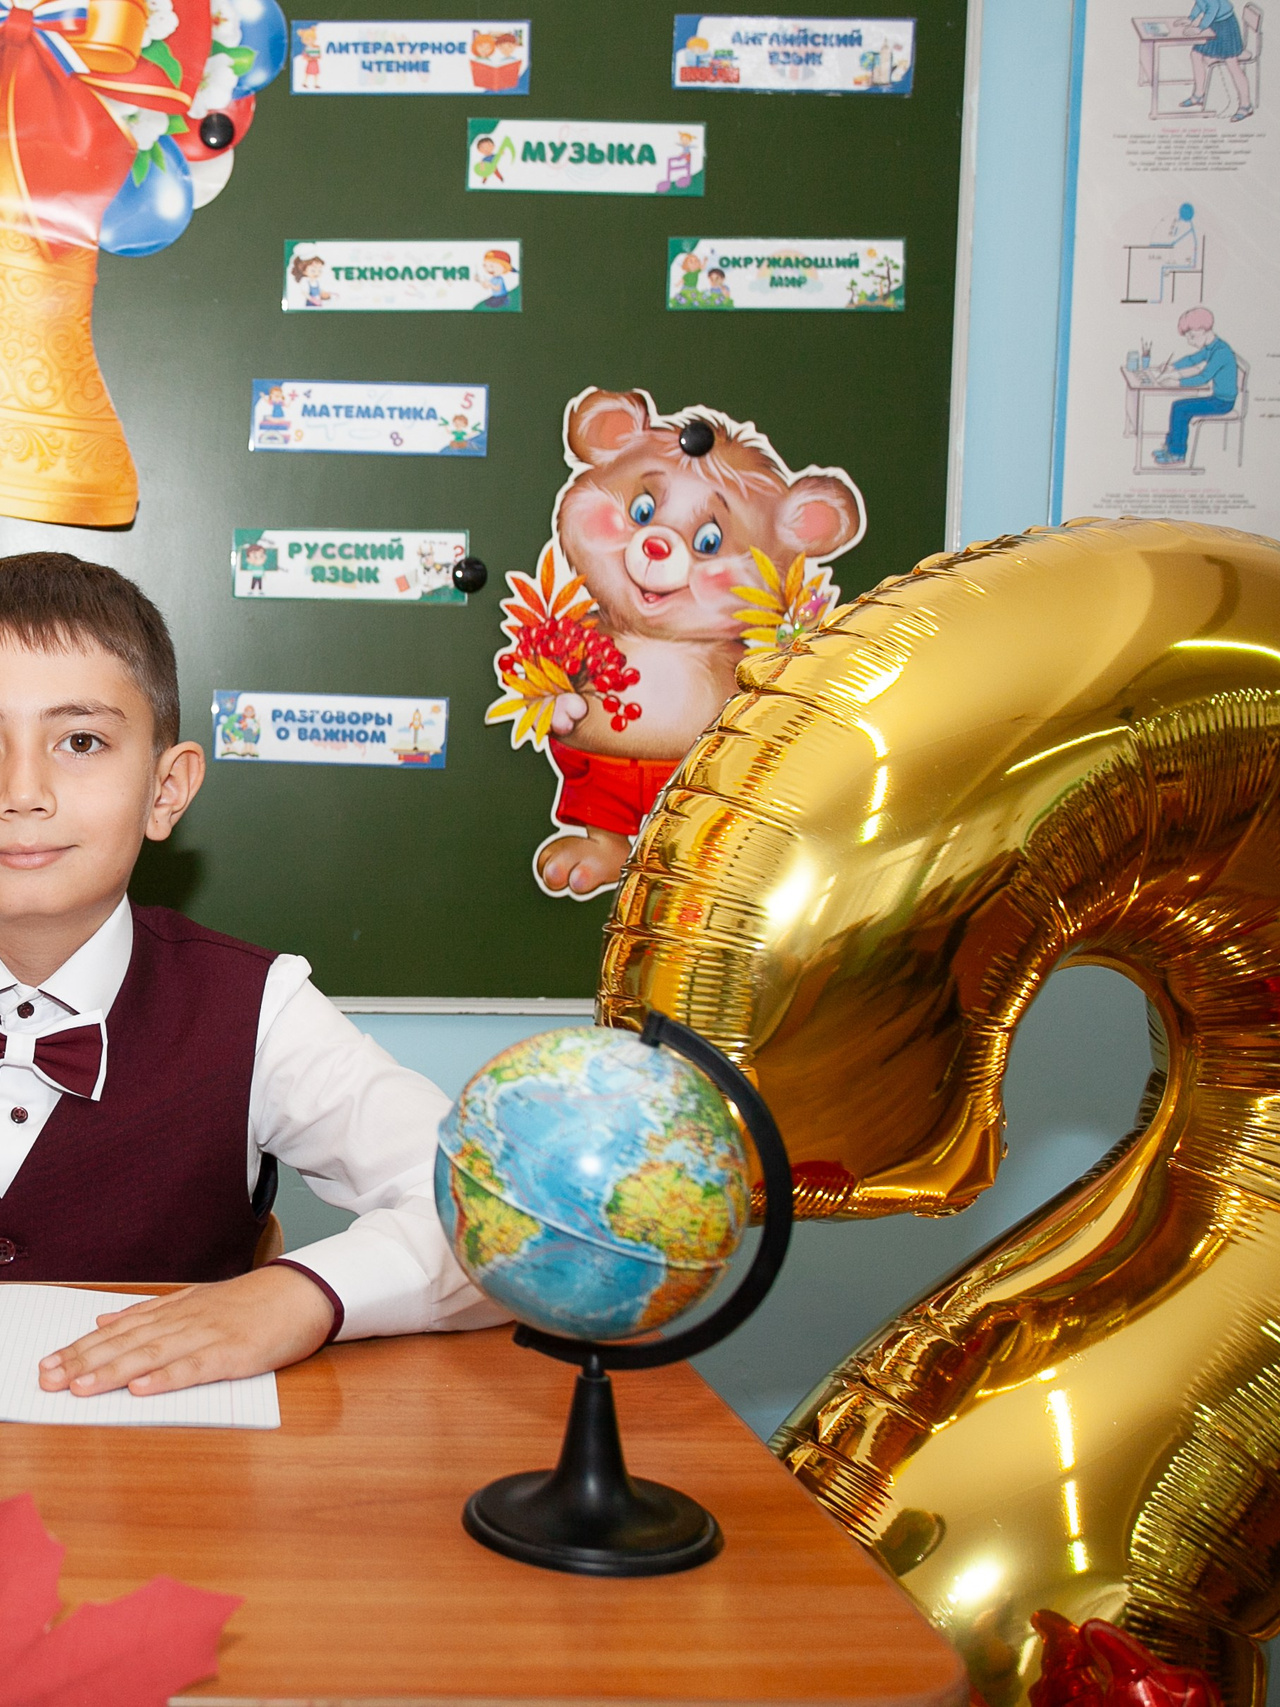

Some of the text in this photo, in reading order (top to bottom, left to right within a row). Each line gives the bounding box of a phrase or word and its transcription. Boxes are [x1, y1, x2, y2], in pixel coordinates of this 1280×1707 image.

[732, 29, 863, 48] АНГЛИЙСКИЙ
[326, 42, 467, 55] ЛИТЕРАТУРНОЕ
[361, 60, 431, 73] ЧТЕНИЕ
[521, 141, 656, 165] МУЗЫКА
[719, 253, 860, 269] ОКРУЖАЮЩИЙ
[332, 267, 470, 282] ТЕХНОЛОГИЯ
[769, 275, 808, 288] МИР
[461, 393, 475, 409] 5
[302, 404, 438, 421] МАТЕМАТИКА
[390, 432, 404, 446] 8
[288, 538, 404, 560] РУССКИЙ
[311, 567, 379, 584] ЯЗЫК
[272, 709, 392, 726] РАЗГОВОРЫ
[276, 729, 386, 743] О ВАЖНОМ
